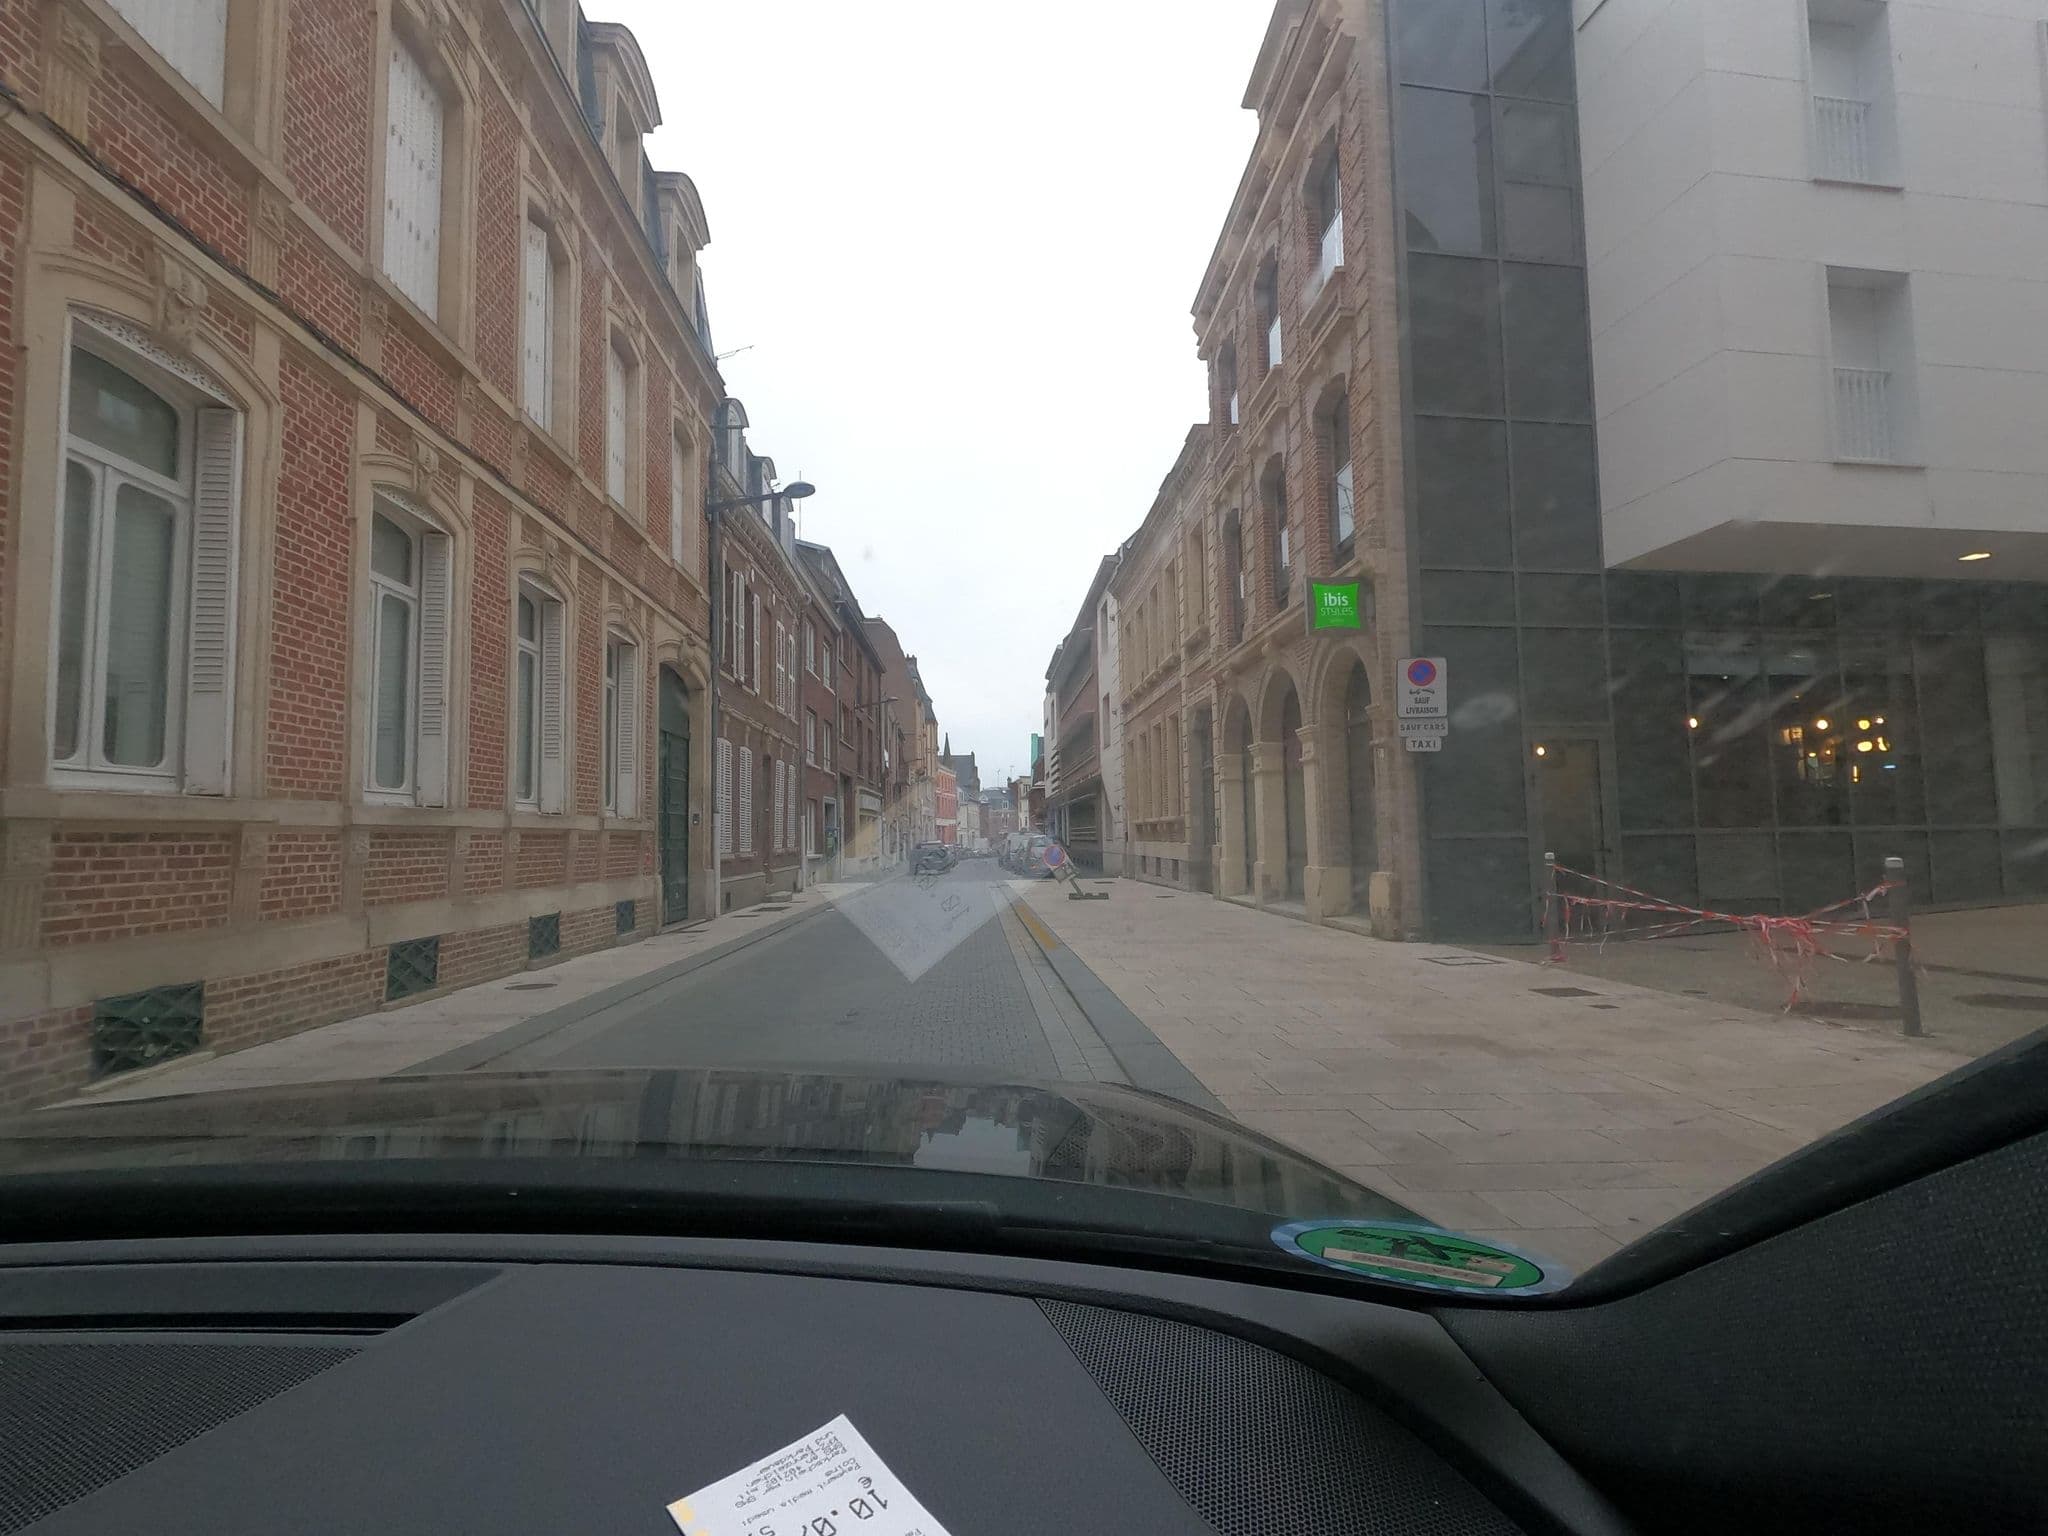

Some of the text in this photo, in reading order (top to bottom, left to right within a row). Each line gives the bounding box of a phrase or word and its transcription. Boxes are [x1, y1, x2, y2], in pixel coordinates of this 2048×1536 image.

[1324, 592, 1349, 607] ibis
[1400, 723, 1446, 731] SAUF CARS
[1411, 740, 1436, 748] TAXI
[856, 1475, 872, 1489] €
